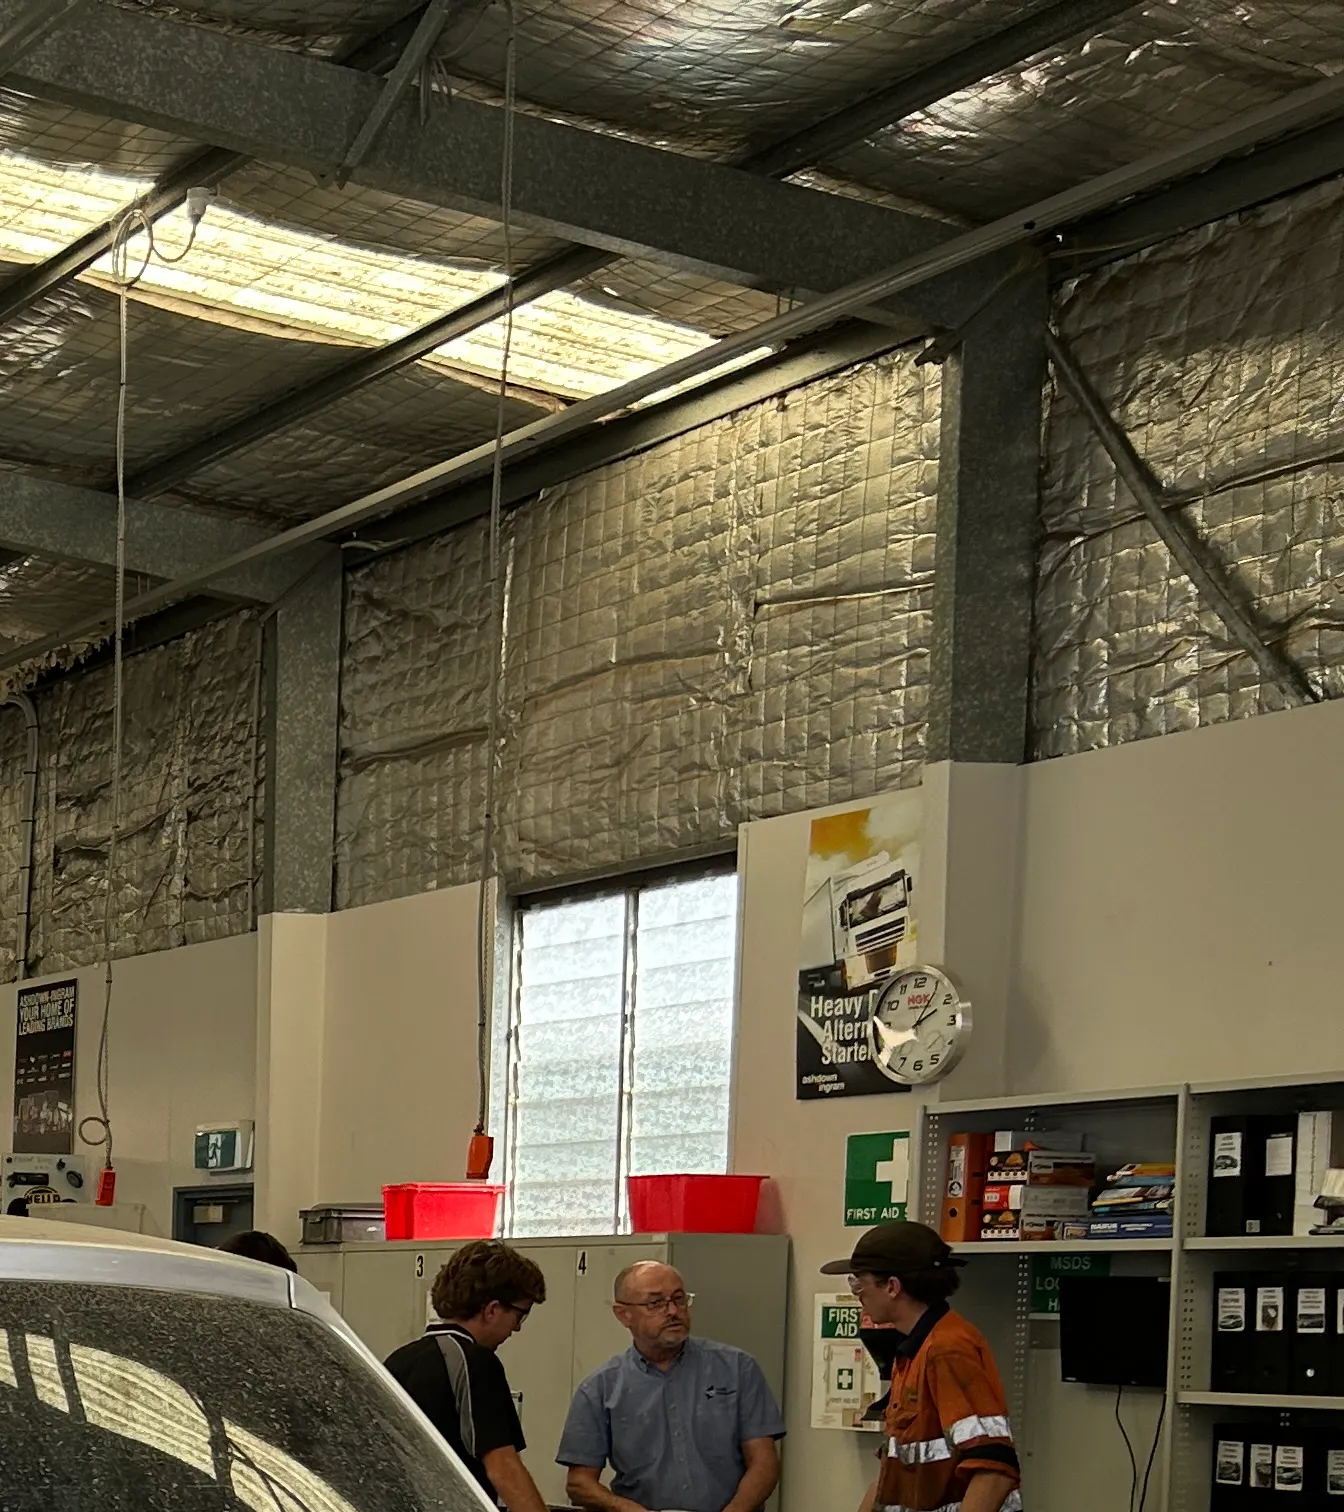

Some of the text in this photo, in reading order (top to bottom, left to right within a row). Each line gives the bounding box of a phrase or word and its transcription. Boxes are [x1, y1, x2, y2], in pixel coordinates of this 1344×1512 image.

[914, 977, 927, 989] 12
[943, 993, 952, 1005] 2
[19, 998, 75, 1022] YOUR HOME OF
[811, 995, 863, 1019] Heavy
[887, 1000, 900, 1012] 10
[46, 1015, 74, 1032] BRANDS
[947, 1015, 957, 1026] 3
[913, 1060, 924, 1071] 6
[929, 1053, 940, 1065] 5
[802, 1073, 838, 1085] ashdown
[818, 1082, 846, 1094] ingram
[847, 1208, 877, 1220] FIRST
[880, 1206, 900, 1219] AID
[416, 1255, 425, 1278] 3
[578, 1251, 587, 1276] 4
[1050, 1255, 1092, 1270] MSDS
[834, 1322, 858, 1337] AID
